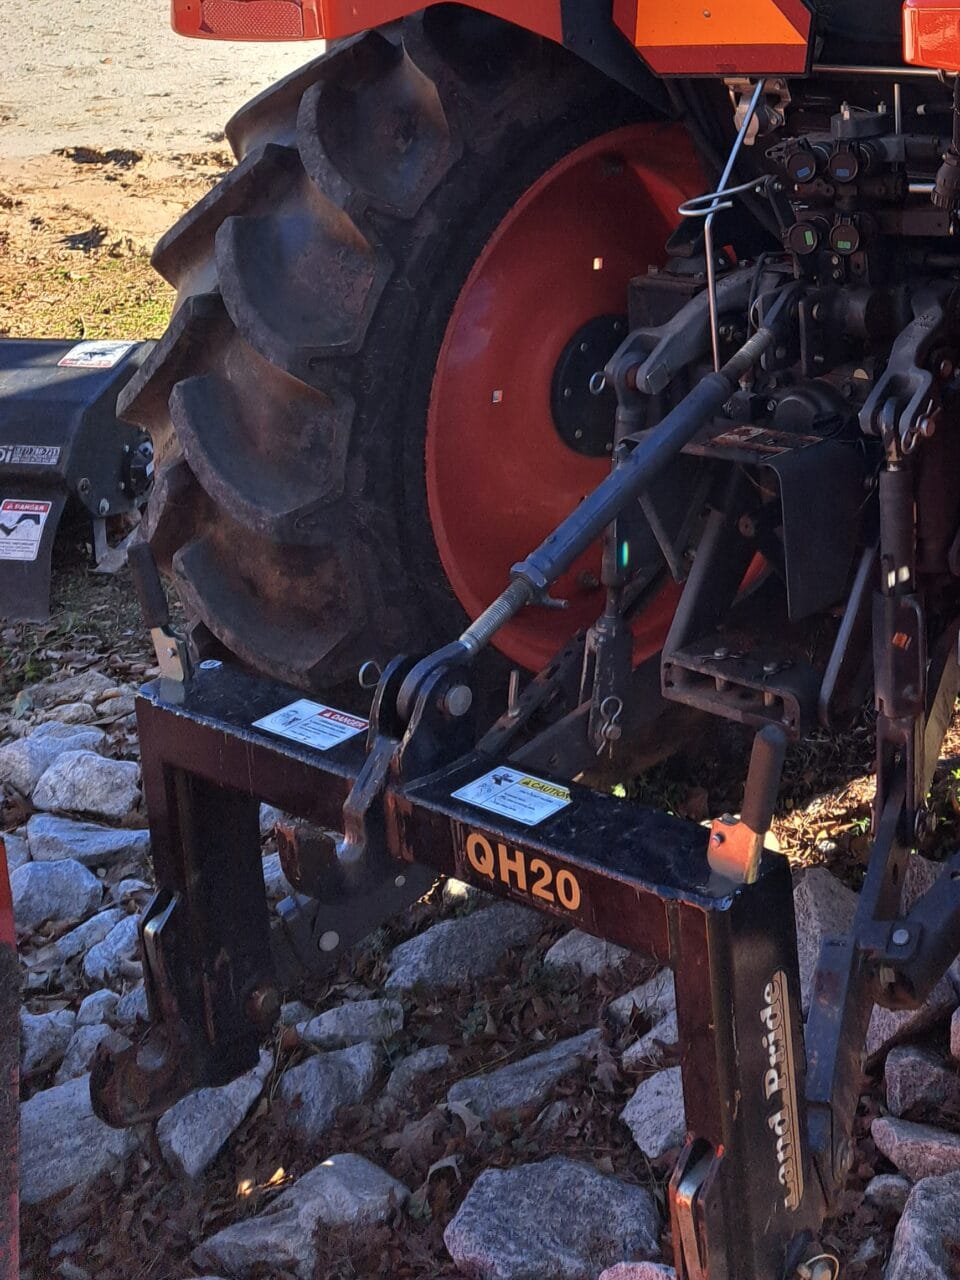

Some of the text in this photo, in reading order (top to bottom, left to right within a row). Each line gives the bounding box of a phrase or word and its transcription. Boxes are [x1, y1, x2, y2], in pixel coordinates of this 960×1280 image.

[14, 502, 46, 511] DANGER
[331, 714, 364, 730] DANGER
[466, 832, 580, 911] QH20
[760, 978, 788, 1101] Pride
